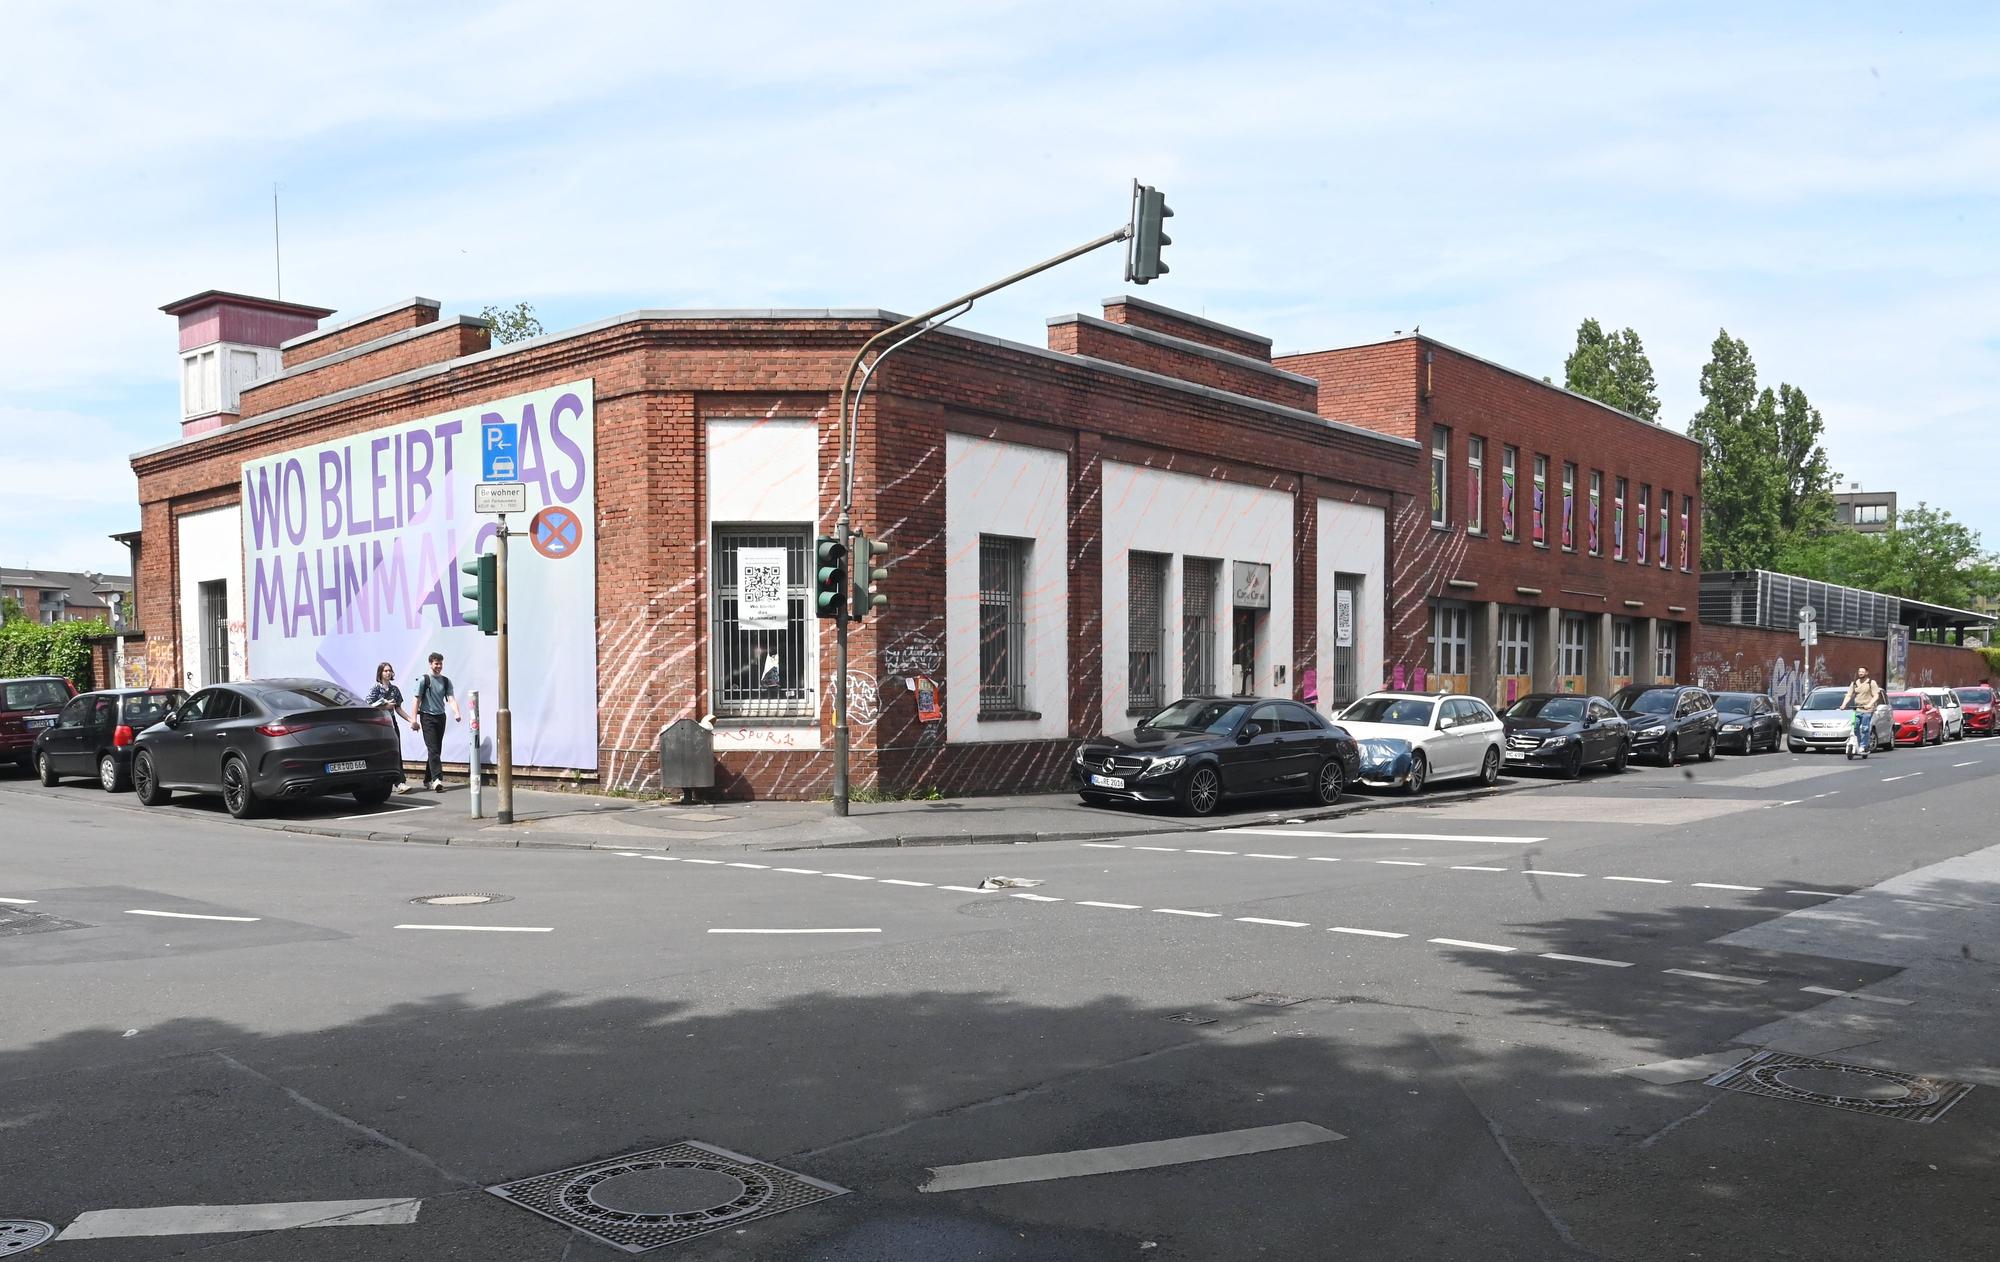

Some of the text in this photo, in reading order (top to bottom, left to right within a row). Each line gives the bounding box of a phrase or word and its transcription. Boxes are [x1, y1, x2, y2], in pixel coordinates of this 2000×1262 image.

[246, 393, 586, 550] WO BLEIBT AS
[487, 428, 502, 450] P
